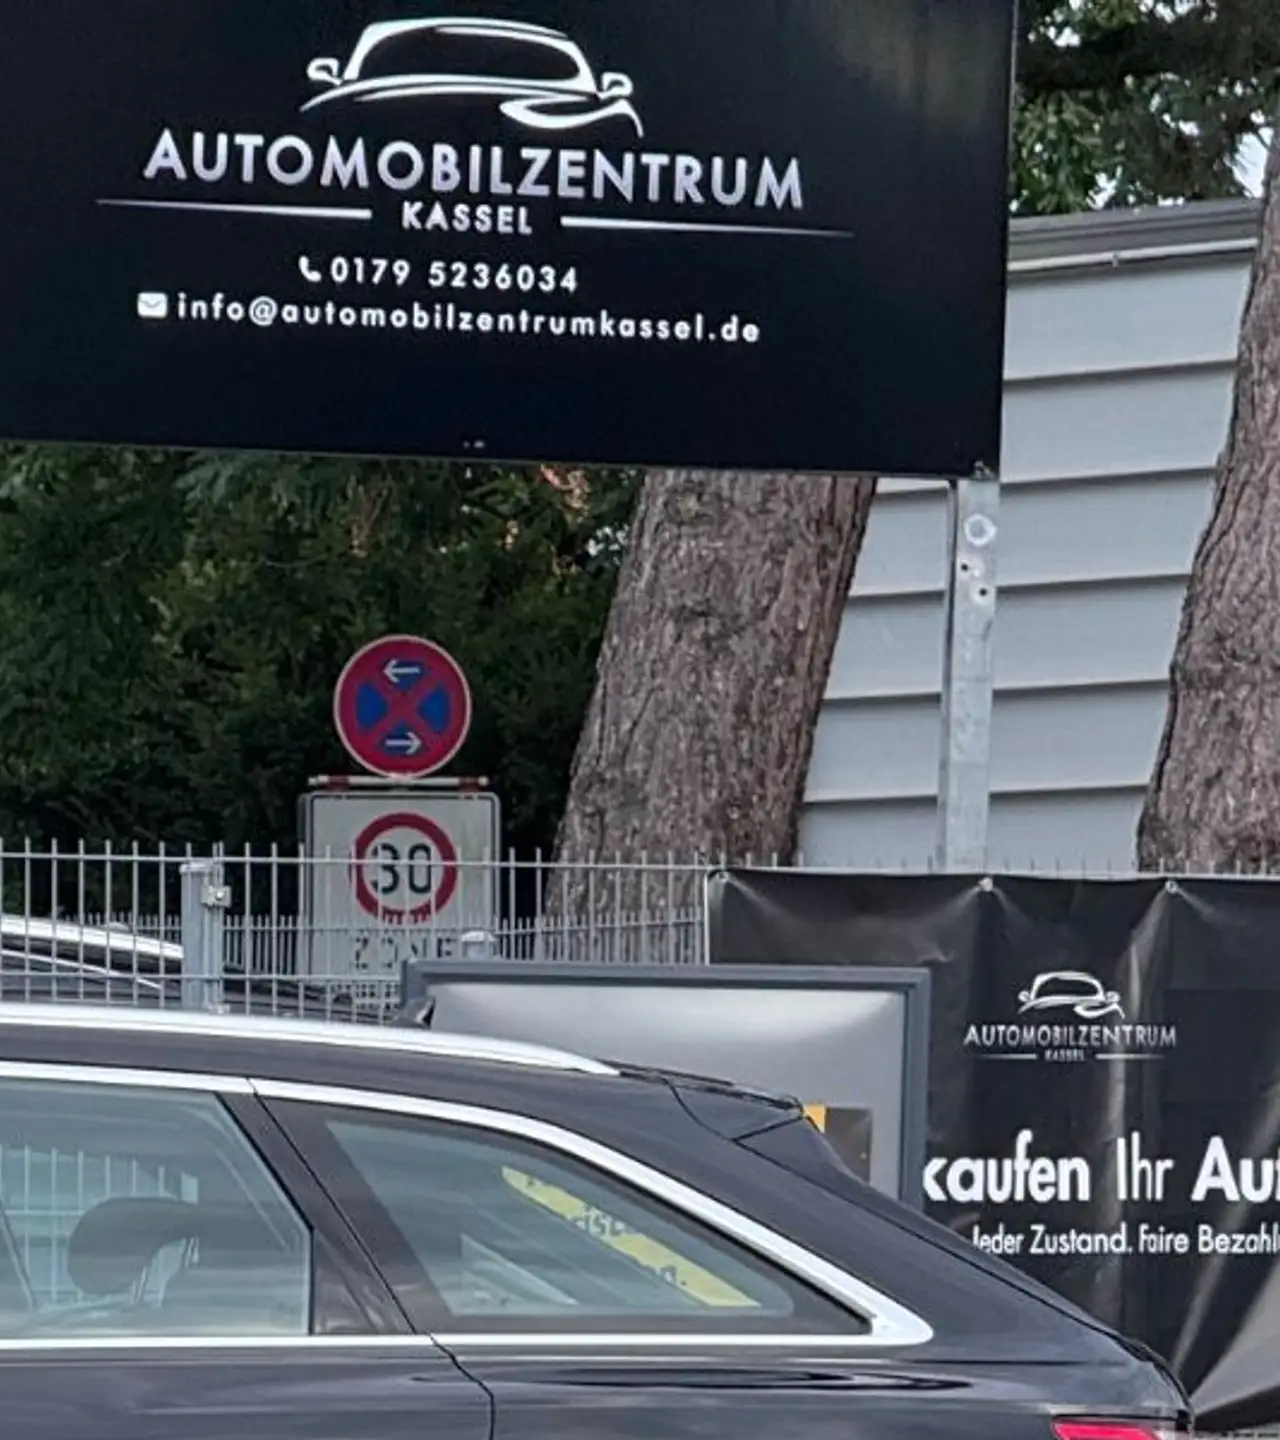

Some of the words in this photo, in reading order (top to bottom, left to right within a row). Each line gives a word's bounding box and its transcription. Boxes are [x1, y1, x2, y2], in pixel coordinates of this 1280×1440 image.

[143, 128, 803, 209] AUTOMOBILZENTRUM
[402, 200, 532, 235] KASSEL
[330, 256, 410, 286] 0179
[428, 261, 577, 293] 5236034
[178, 292, 760, 343] info@automobilzentrumkassel.de
[371, 842, 432, 895] 30
[963, 1024, 1177, 1048] AUTOMOBILZENTRUM
[1116, 1131, 1174, 1201] Ihr
[1191, 1136, 1280, 1203] Au
[1030, 1221, 1133, 1255] Zustand.
[1198, 1221, 1280, 1255] Bezahl
